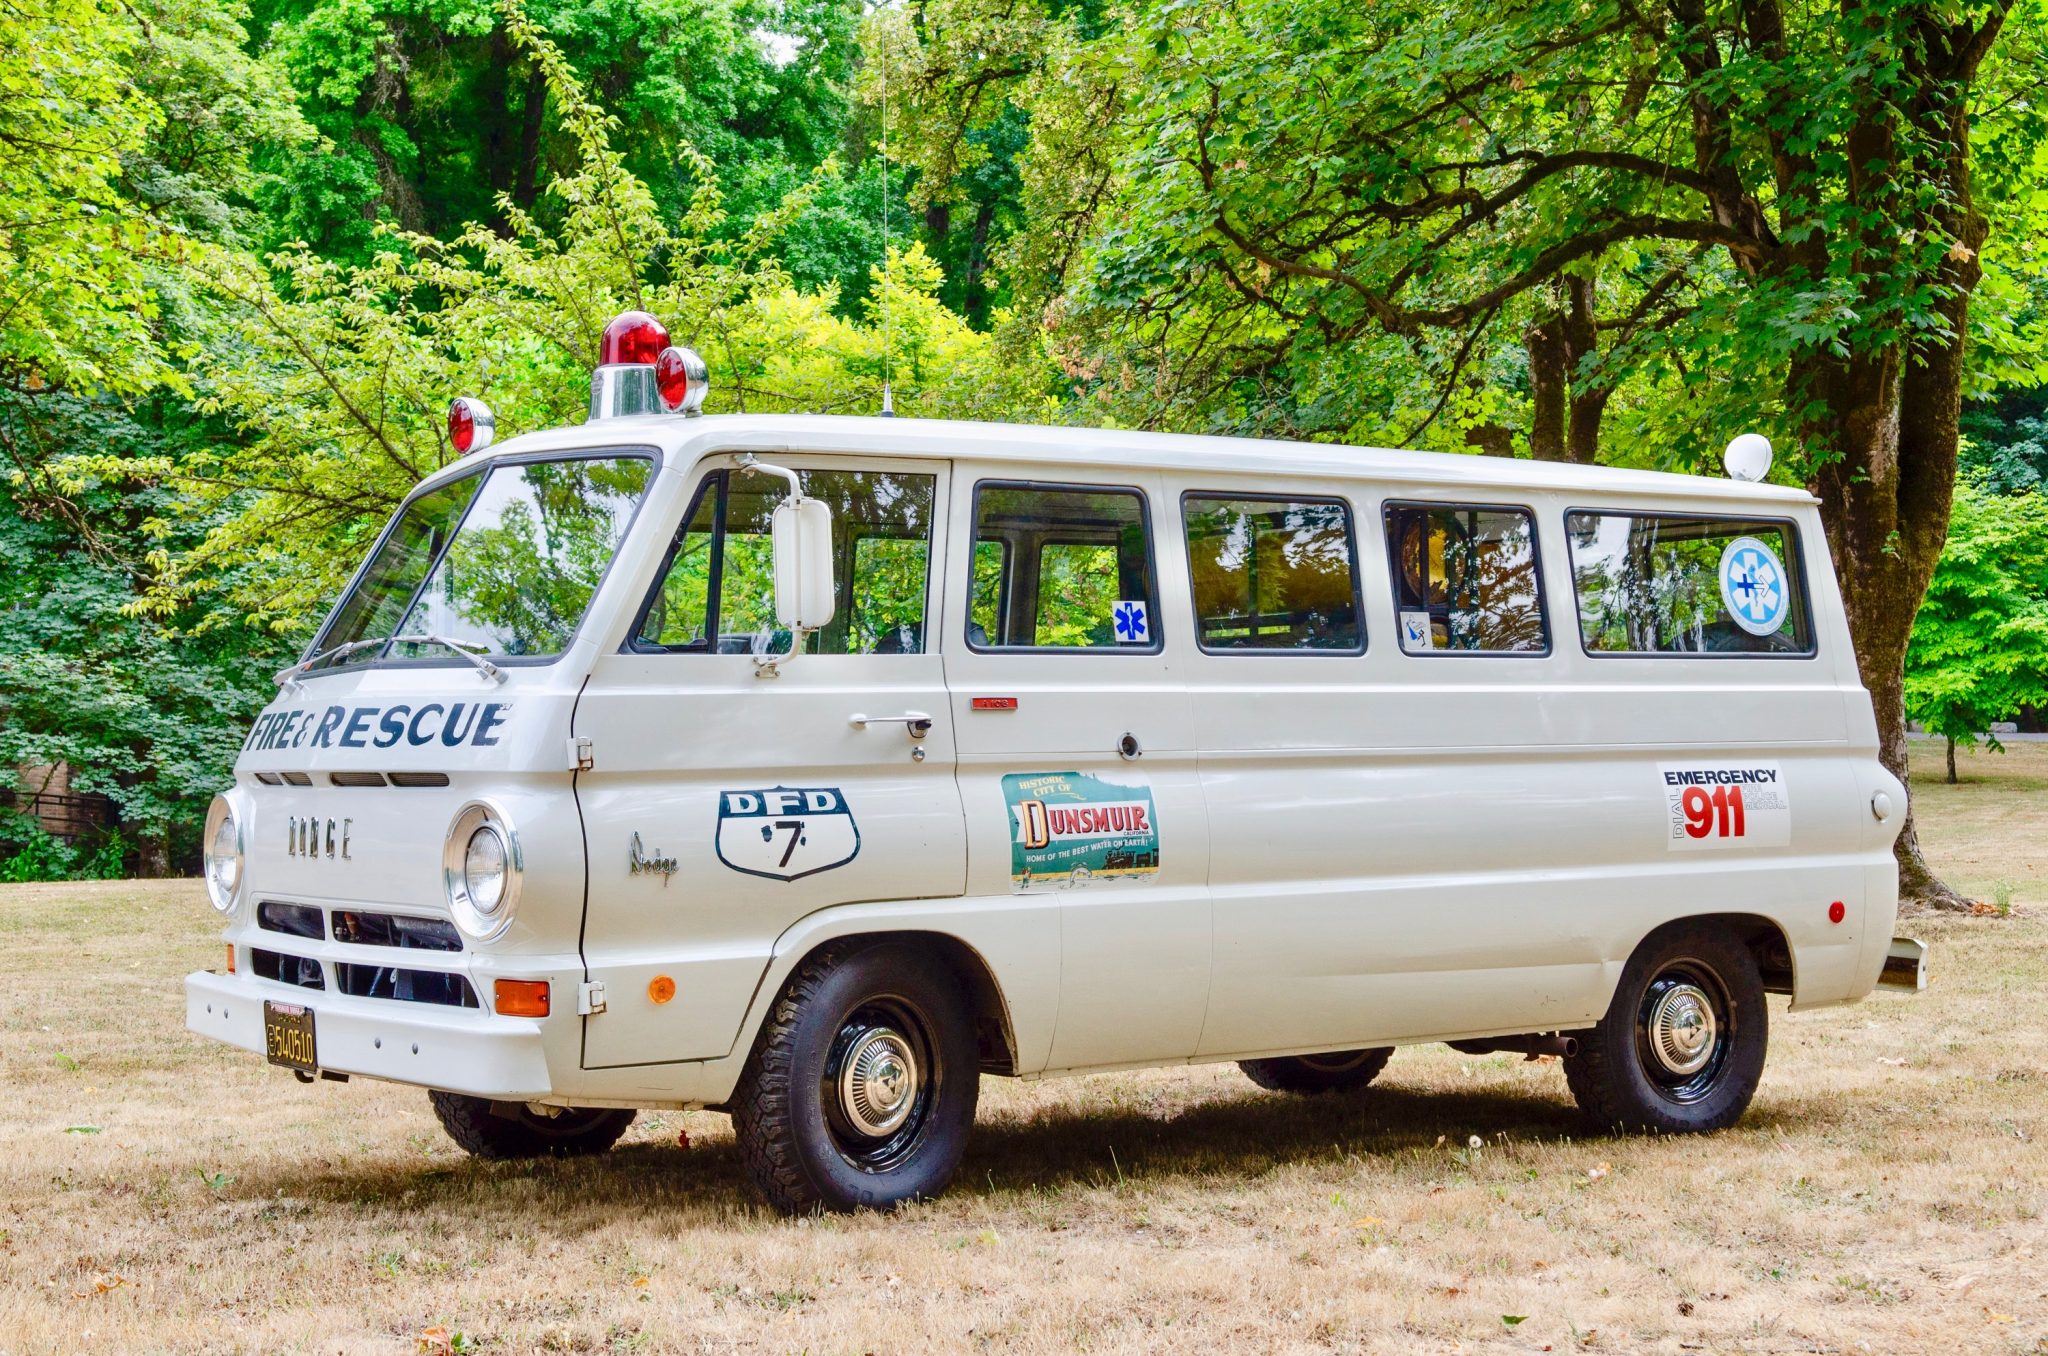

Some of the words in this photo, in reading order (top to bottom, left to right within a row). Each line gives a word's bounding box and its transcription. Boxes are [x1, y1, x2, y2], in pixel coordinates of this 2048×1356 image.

[246, 710, 304, 751] FIRE
[310, 703, 512, 748] RESCUE
[1018, 775, 1065, 790] HISTORIC
[1033, 786, 1056, 797] CITY
[1058, 783, 1072, 793] OF
[1664, 769, 1776, 785] EMERGENCY
[726, 791, 837, 815] DFD
[1669, 788, 1684, 839] DIAL
[1682, 786, 1745, 838] 911
[775, 821, 803, 867] 7
[1019, 800, 1149, 849] DUNSMUIR
[1026, 854, 1046, 863] HOME
[1047, 852, 1056, 861] OF
[1058, 850, 1070, 859] THE
[1072, 846, 1089, 856] BEST
[1091, 839, 1112, 851] WATER
[1113, 839, 1124, 847] ON
[275, 1025, 314, 1064] 540510
